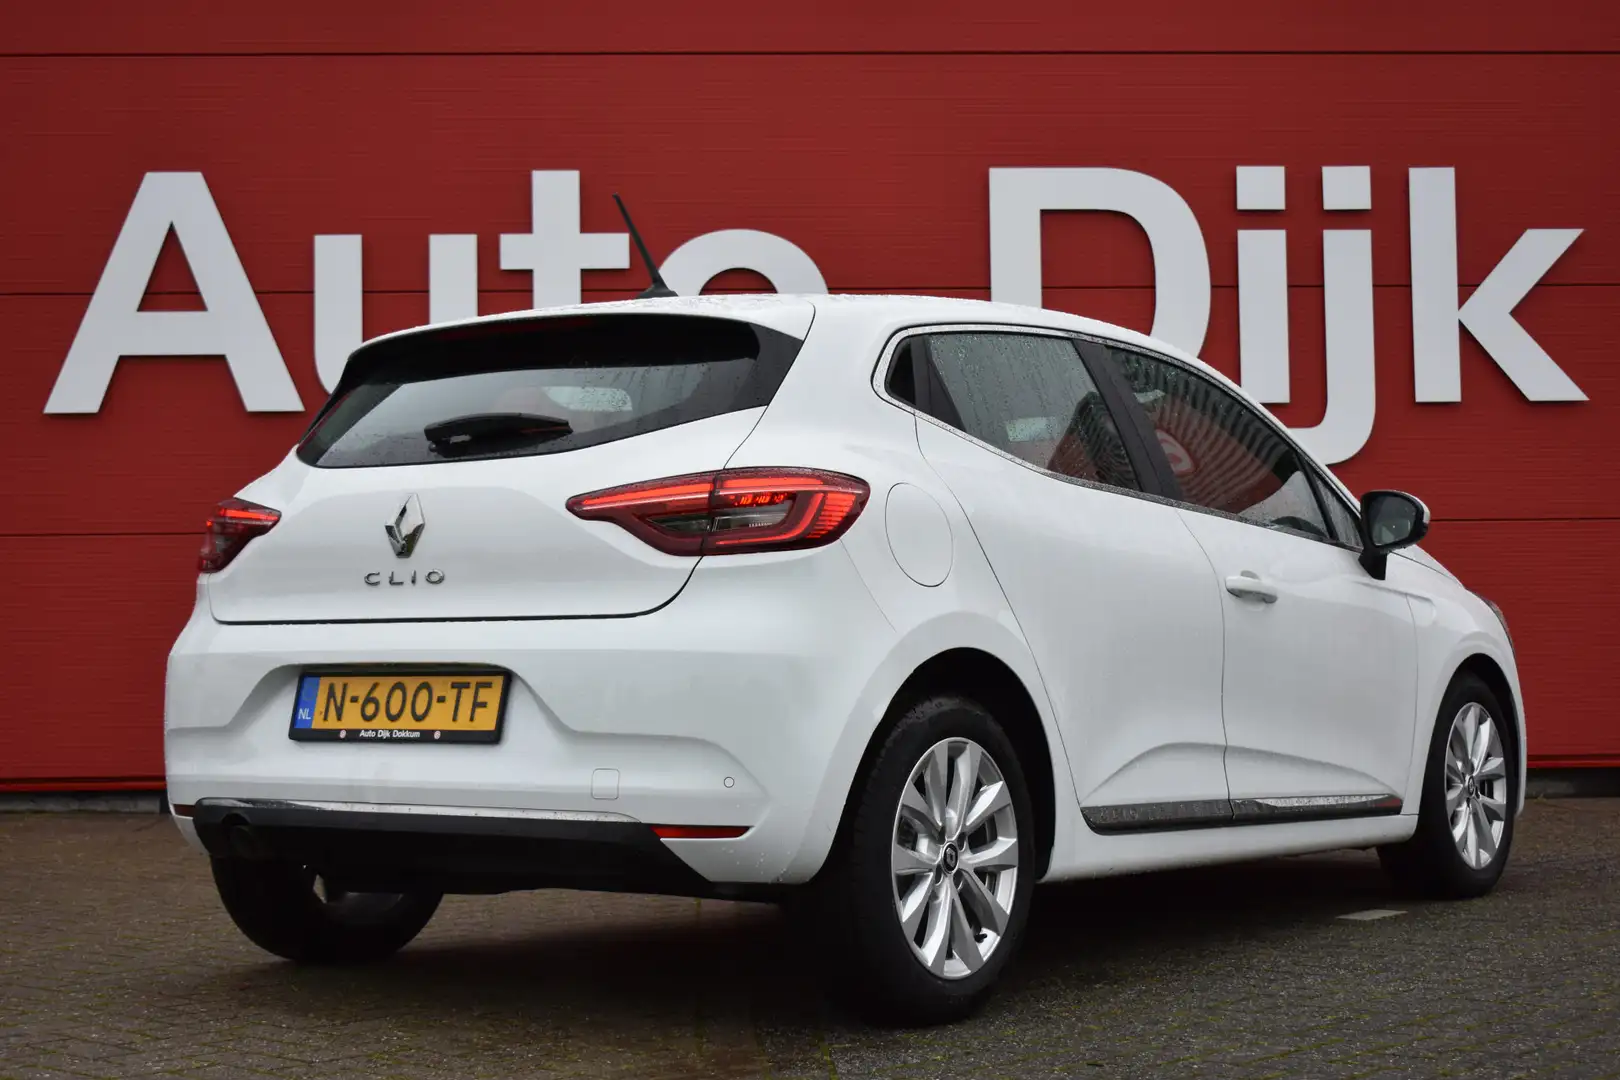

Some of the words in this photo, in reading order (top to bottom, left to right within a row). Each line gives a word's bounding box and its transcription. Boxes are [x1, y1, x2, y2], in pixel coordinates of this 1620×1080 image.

[989, 165, 1590, 464] Dijk
[364, 568, 445, 586] CLIO
[323, 681, 493, 722] N-600-TF
[298, 708, 311, 720] NL
[360, 729, 376, 738] Auto
[377, 729, 391, 739] Dijk
[393, 730, 420, 738] Dokkum
